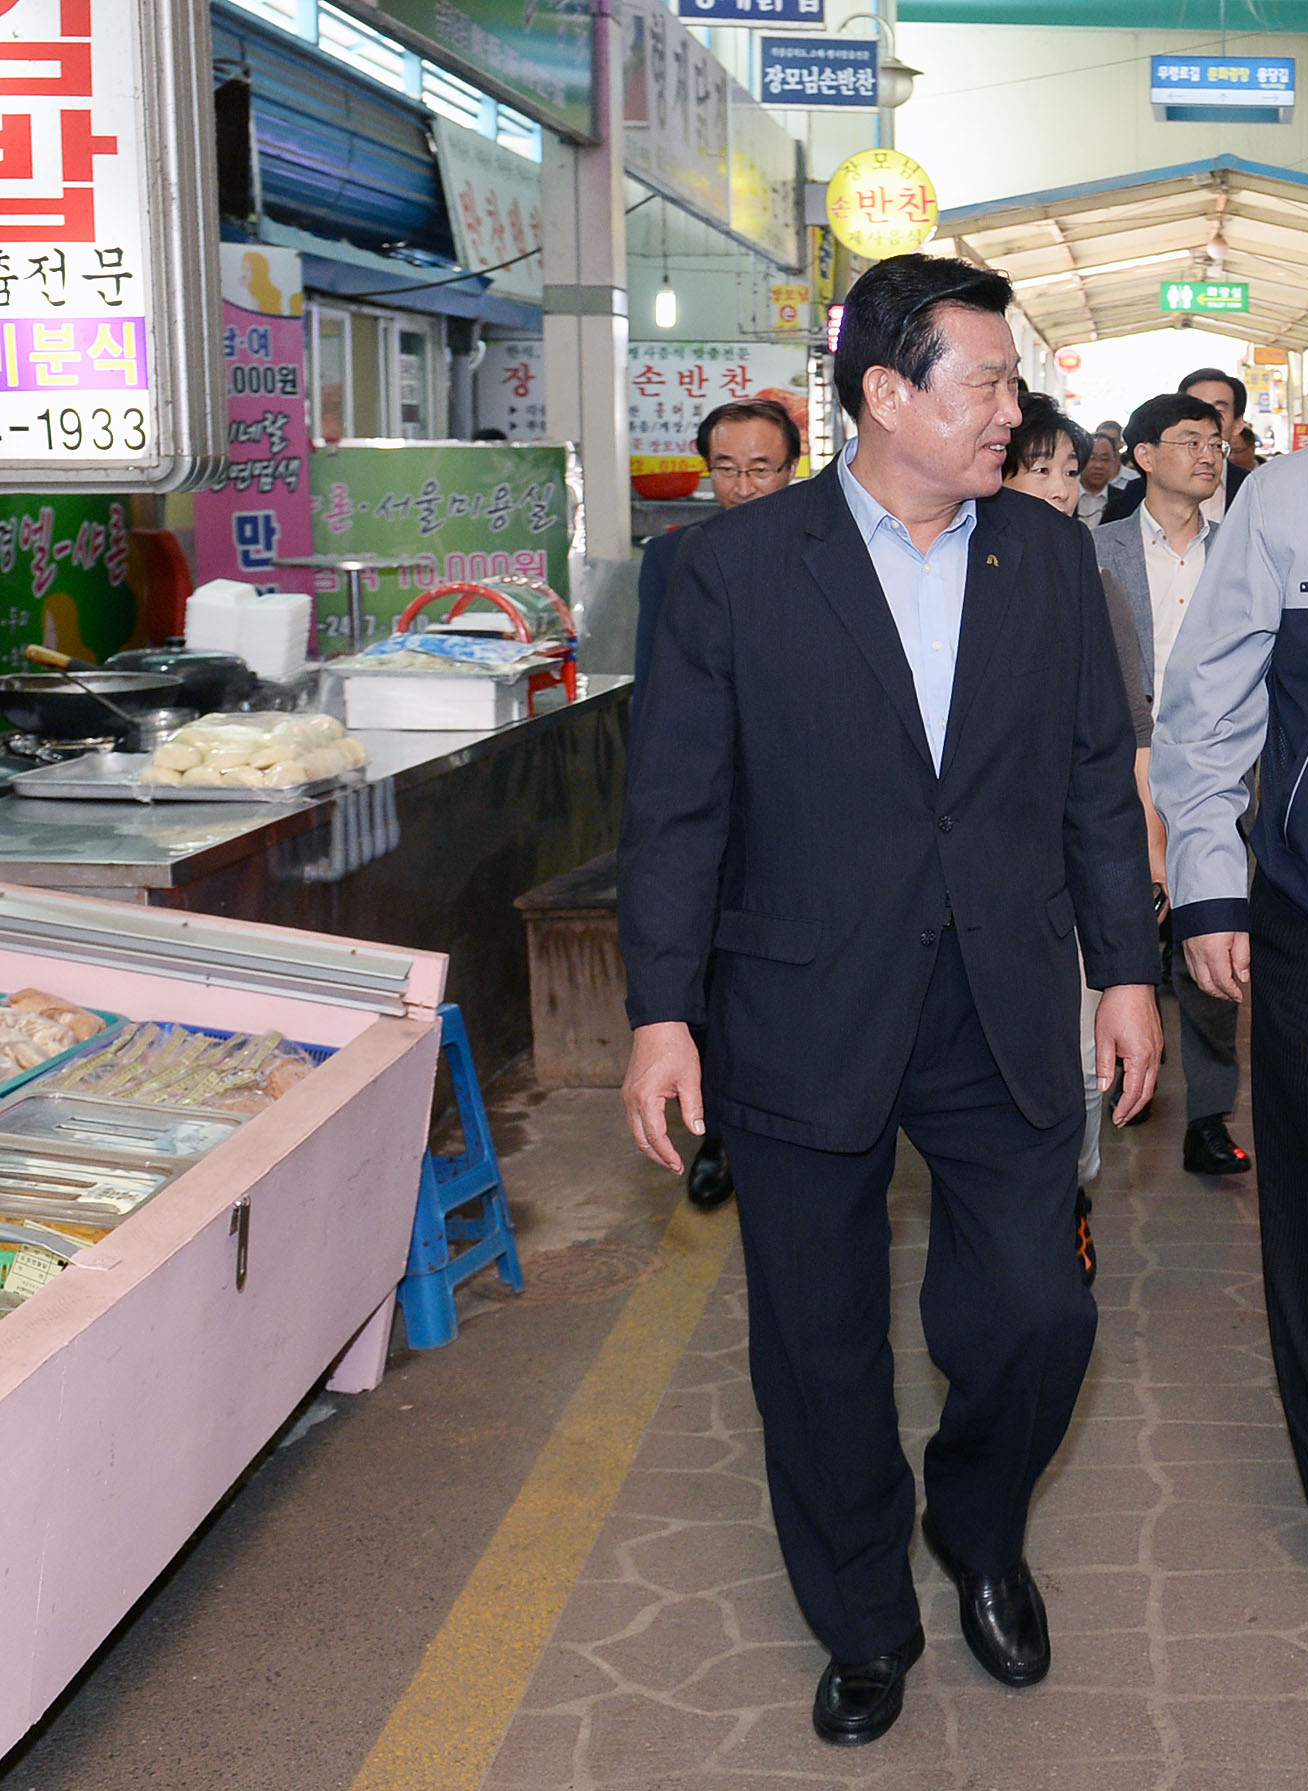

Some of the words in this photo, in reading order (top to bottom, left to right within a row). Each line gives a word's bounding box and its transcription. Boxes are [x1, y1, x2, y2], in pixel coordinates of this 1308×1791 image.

[764, 64, 876, 96] 장모님손반찬
[842, 152, 921, 181] 장모님
[831, 184, 936, 224] 손반찬
[632, 363, 752, 398] 손반찬
